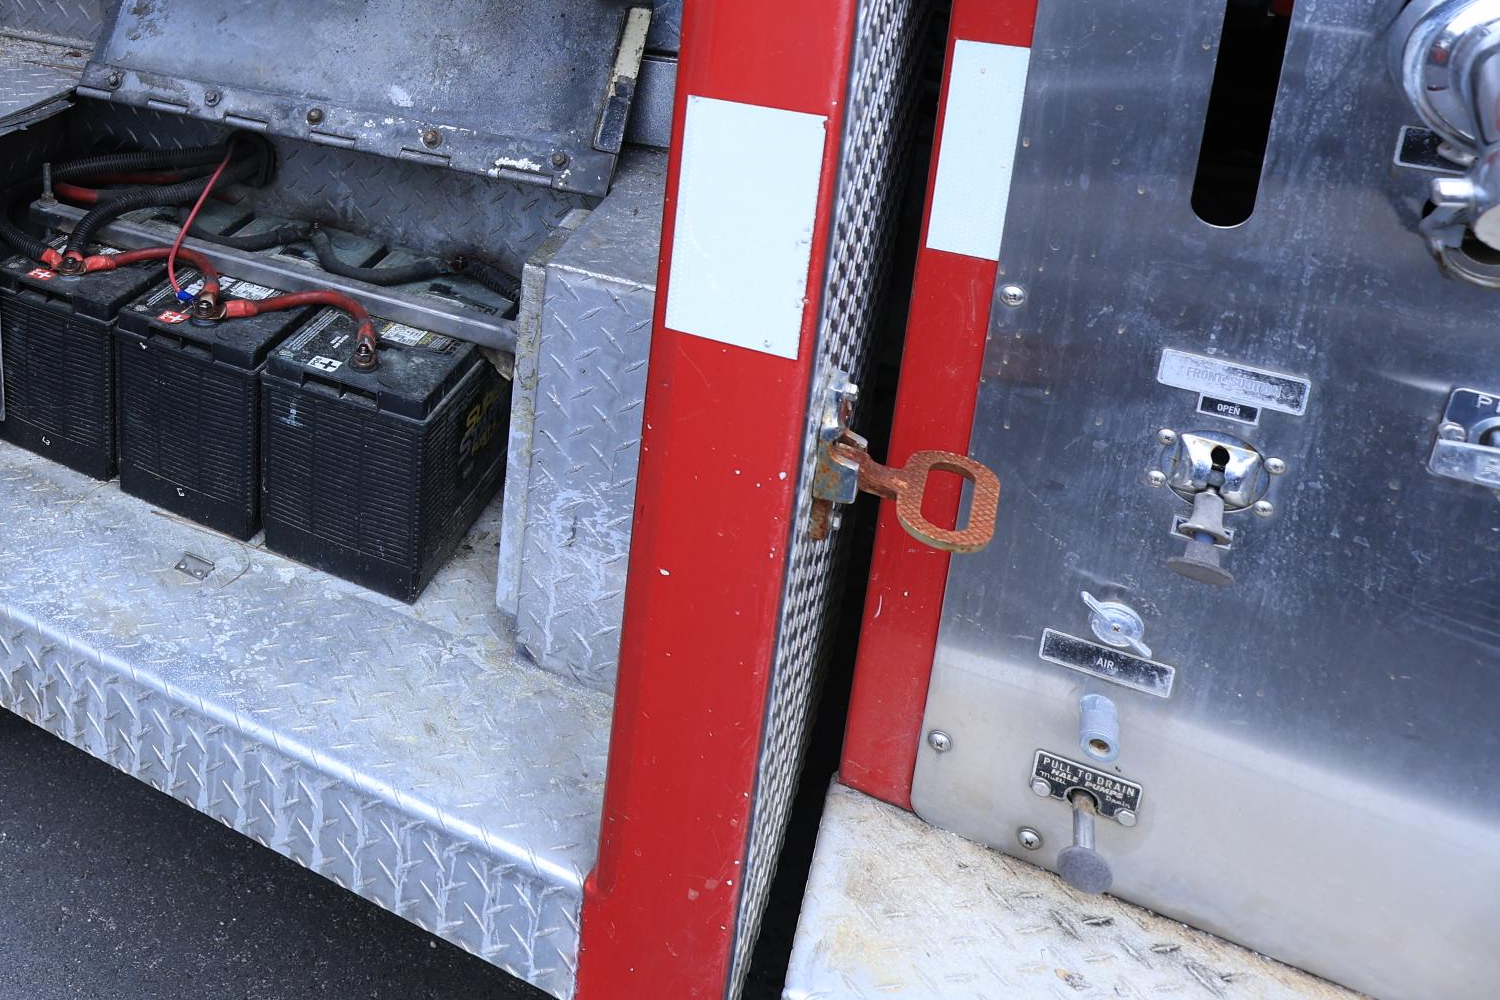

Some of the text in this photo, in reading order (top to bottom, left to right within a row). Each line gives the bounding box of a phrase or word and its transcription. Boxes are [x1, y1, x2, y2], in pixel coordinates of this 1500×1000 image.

[1187, 366, 1282, 399] FRONT SUCTION
[1217, 403, 1241, 416] OPEN
[1096, 657, 1115, 670] AIR
[1043, 757, 1135, 797] PULL TO DRAIN
[1051, 769, 1124, 799] HALE PUMPS
